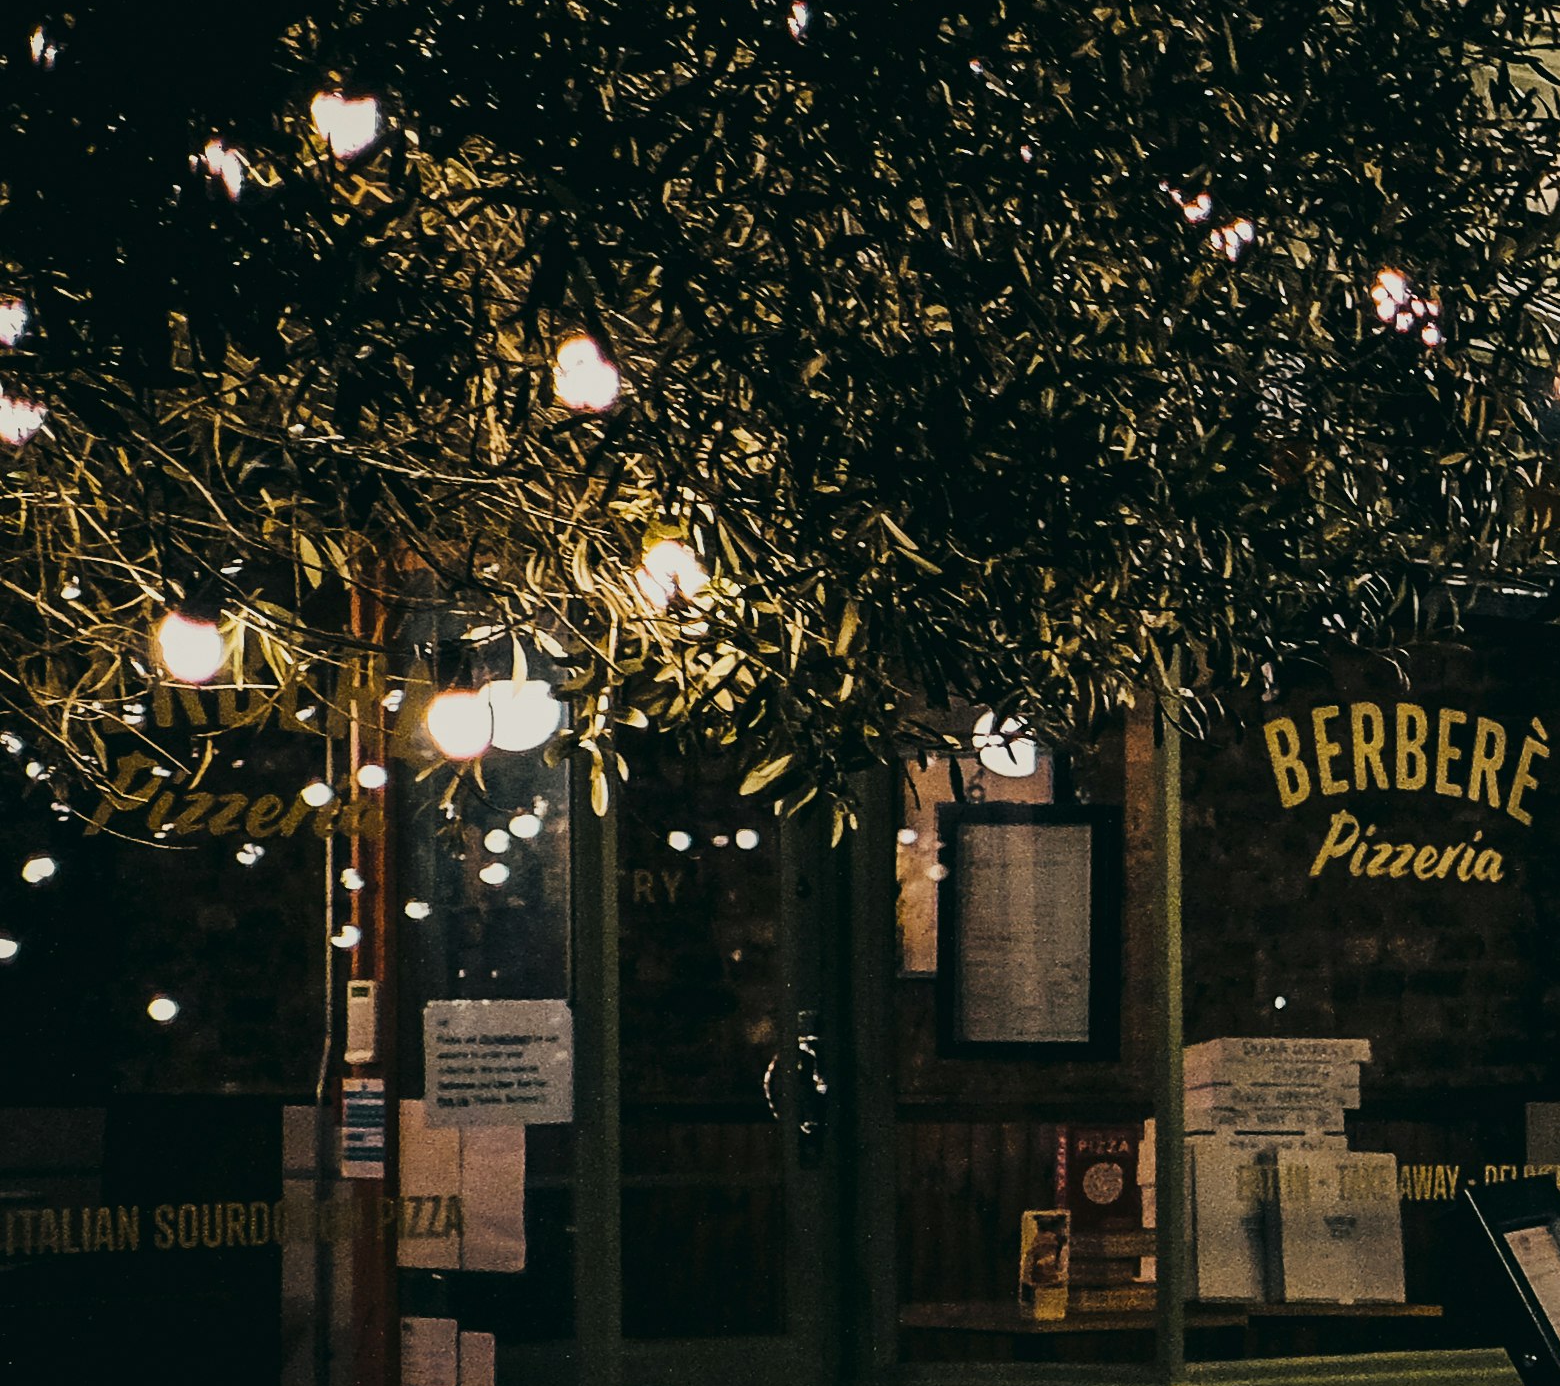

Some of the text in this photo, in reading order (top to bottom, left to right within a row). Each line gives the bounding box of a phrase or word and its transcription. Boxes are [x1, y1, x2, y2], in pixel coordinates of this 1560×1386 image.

[1262, 700, 1551, 827] BERBERÈ
[1308, 808, 1505, 883] Pizzeria
[1077, 1139, 1130, 1154] PIZZA
[1400, 1163, 1461, 1202] AWAY
[5, 1206, 141, 1257] ITALIAN
